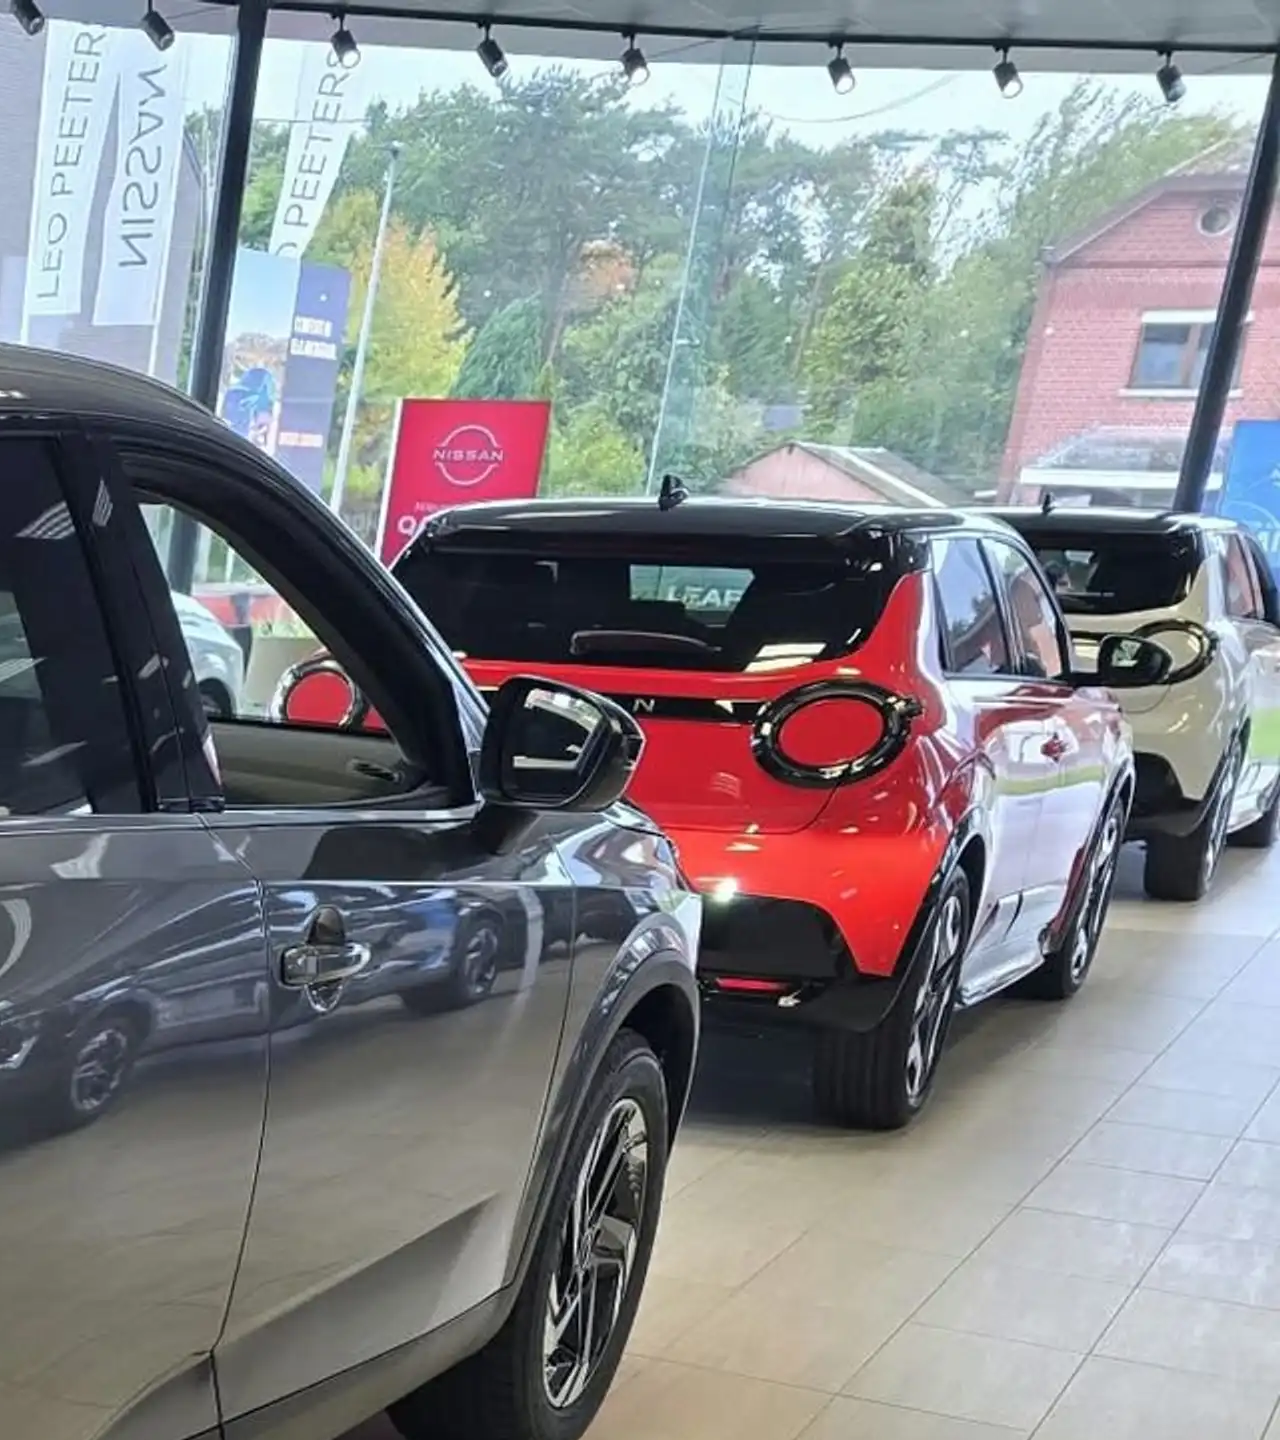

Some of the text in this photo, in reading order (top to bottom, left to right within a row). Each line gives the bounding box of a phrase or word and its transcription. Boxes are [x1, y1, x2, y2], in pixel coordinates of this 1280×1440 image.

[37, 29, 108, 299] LEO PEETER
[432, 448, 504, 461] NISSAN
